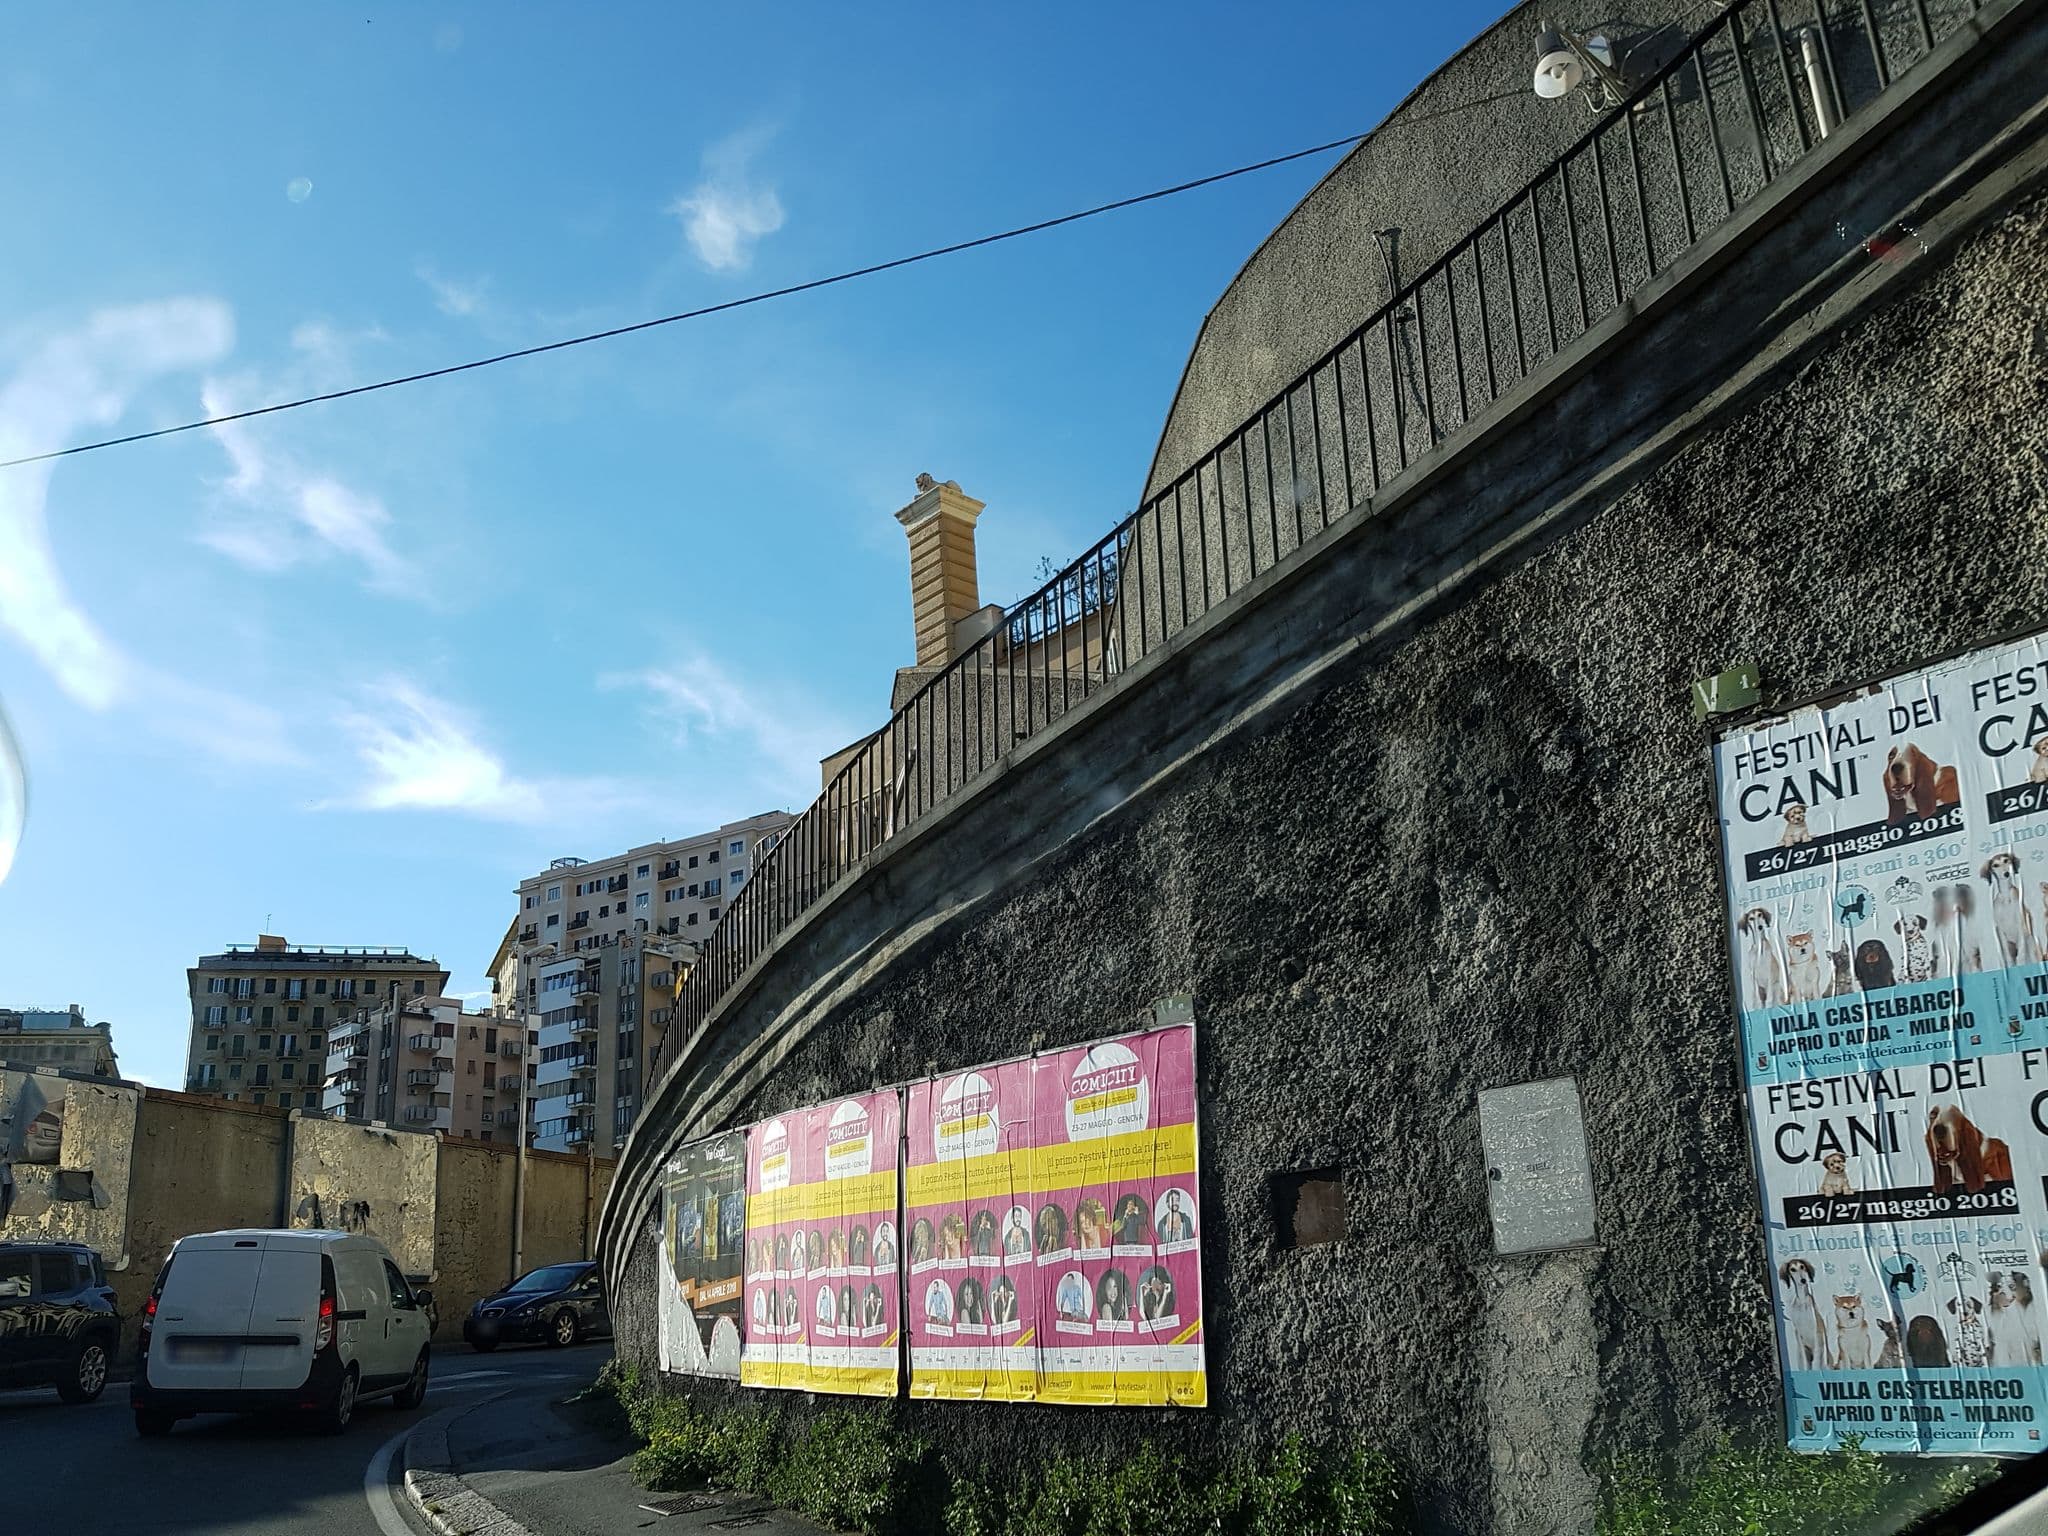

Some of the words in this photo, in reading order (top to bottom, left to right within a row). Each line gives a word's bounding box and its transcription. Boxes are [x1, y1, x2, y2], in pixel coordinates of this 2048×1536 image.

[1735, 718, 1874, 780] FESTIVAL
[1889, 695, 1941, 735] DEI
[1739, 758, 1860, 822] CANI
[2003, 785, 2048, 813] 26/
[1758, 847, 1818, 873] 26/27
[1823, 826, 1903, 858] maggio
[1909, 808, 1964, 836] 2018
[1864, 855, 1902, 877] cani
[1908, 853, 1919, 866] a
[1771, 1012, 1819, 1036] VILLA
[1826, 987, 1965, 1027] CASTELBARCO
[1768, 1035, 1823, 1056] VAPRIO
[1829, 1025, 1891, 1048] D'ADDA
[1909, 1012, 1975, 1036] MILANO
[1072, 1066, 1137, 1094] COMICITY
[1767, 1068, 1915, 1114] FESTIVAL
[1929, 1057, 1987, 1094] DEI
[828, 1121, 868, 1141] COMICITY
[1775, 1111, 1901, 1164] CANI
[1055, 1155, 1077, 1169] primo
[1111, 1147, 1130, 1157] tutto
[1132, 1144, 1142, 1153] da
[1799, 1200, 1860, 1222] 26/27
[1866, 1192, 1950, 1219] maggio
[1957, 1186, 2017, 1210] 2018
[1911, 1226, 1951, 1246] cani
[1819, 1381, 1871, 1400] VILLA
[1878, 1379, 2024, 1400] CASTELBARCO
[1814, 1406, 1875, 1422] VAPRIO
[1882, 1405, 1945, 1422] D'ADDA
[1965, 1406, 2034, 1422] MILANO
